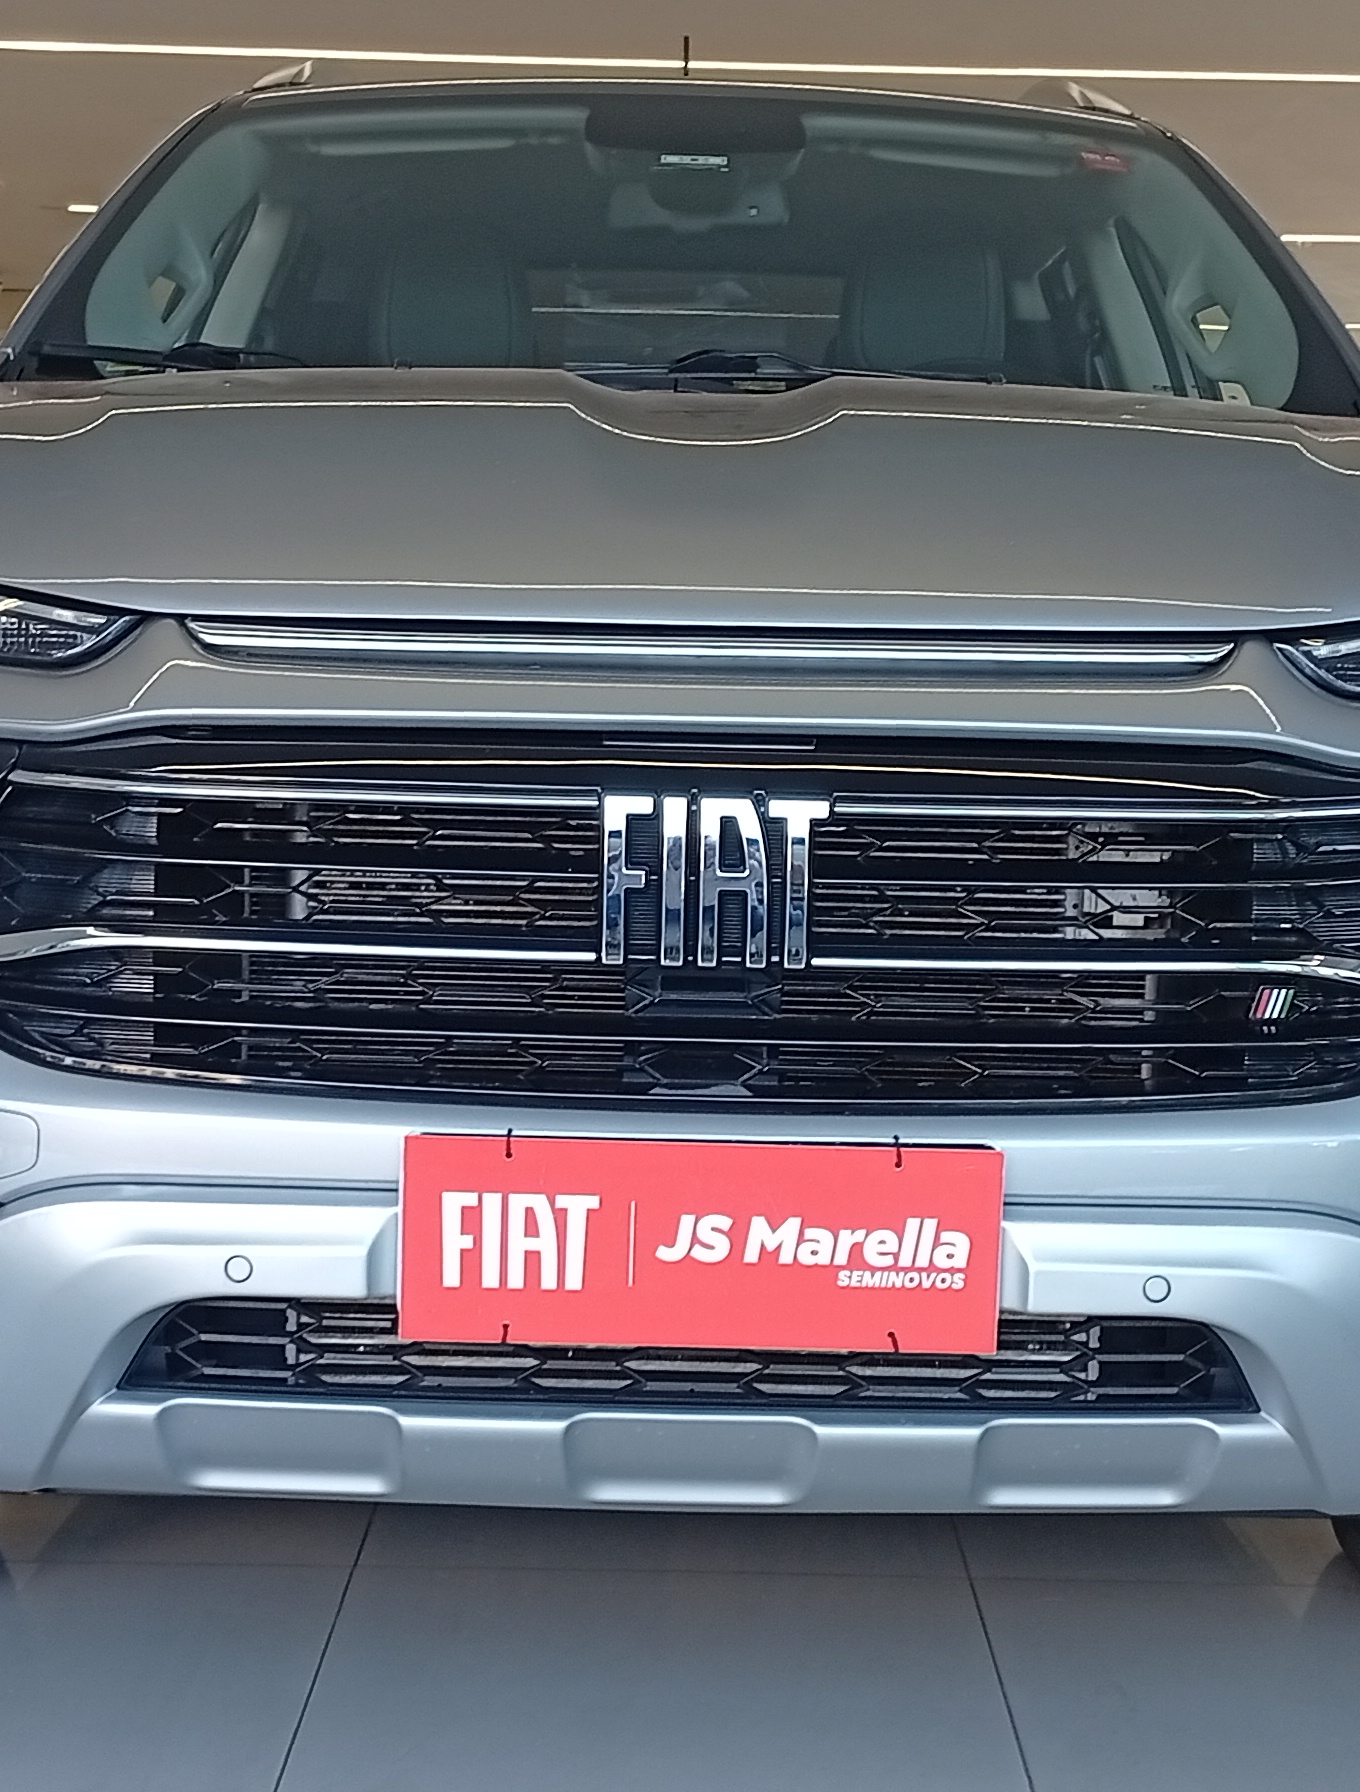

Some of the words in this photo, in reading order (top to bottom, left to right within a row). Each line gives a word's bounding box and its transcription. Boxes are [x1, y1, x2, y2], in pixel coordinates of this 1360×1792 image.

[601, 795, 831, 969] FIAT
[441, 1191, 600, 1291] FIAT
[654, 1213, 734, 1263] JS
[742, 1215, 971, 1269] Marella
[836, 1269, 966, 1290] SEMINOVOS
